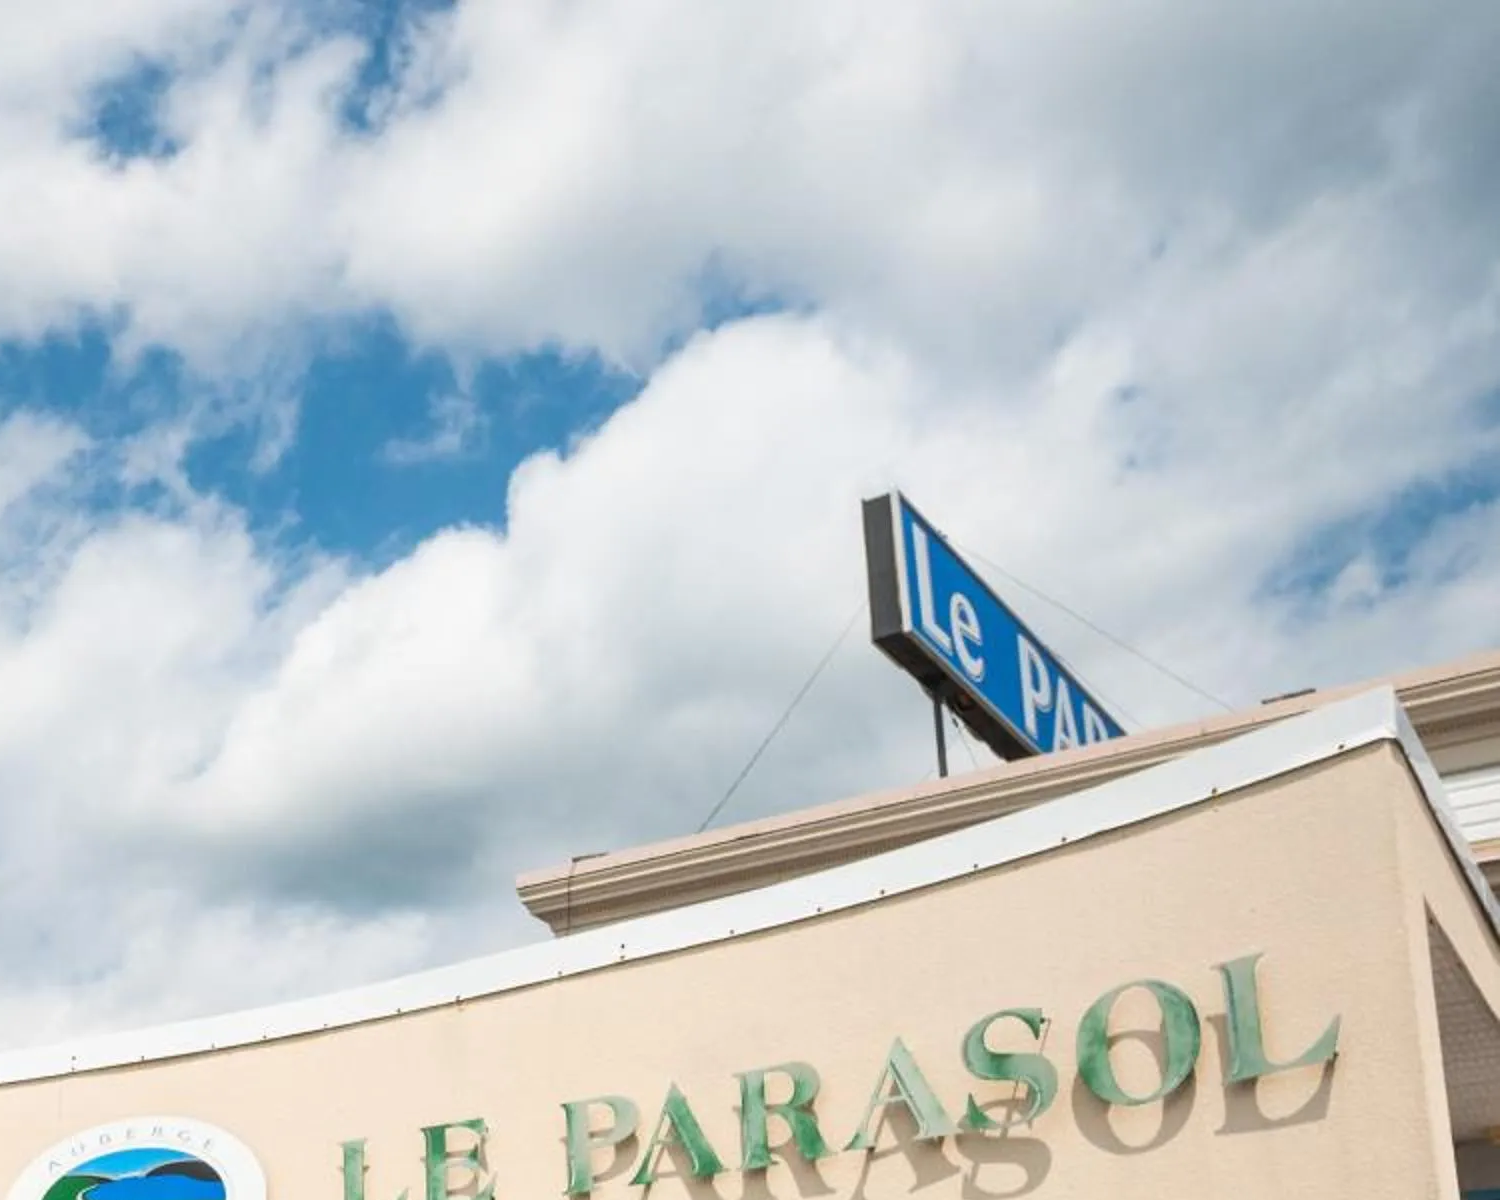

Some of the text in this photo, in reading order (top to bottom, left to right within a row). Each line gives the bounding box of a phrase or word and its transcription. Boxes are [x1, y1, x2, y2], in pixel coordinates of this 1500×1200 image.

[911, 520, 985, 682] Le
[47, 1125, 217, 1175] AUBERGE
[559, 952, 1342, 1199] PARASOL
